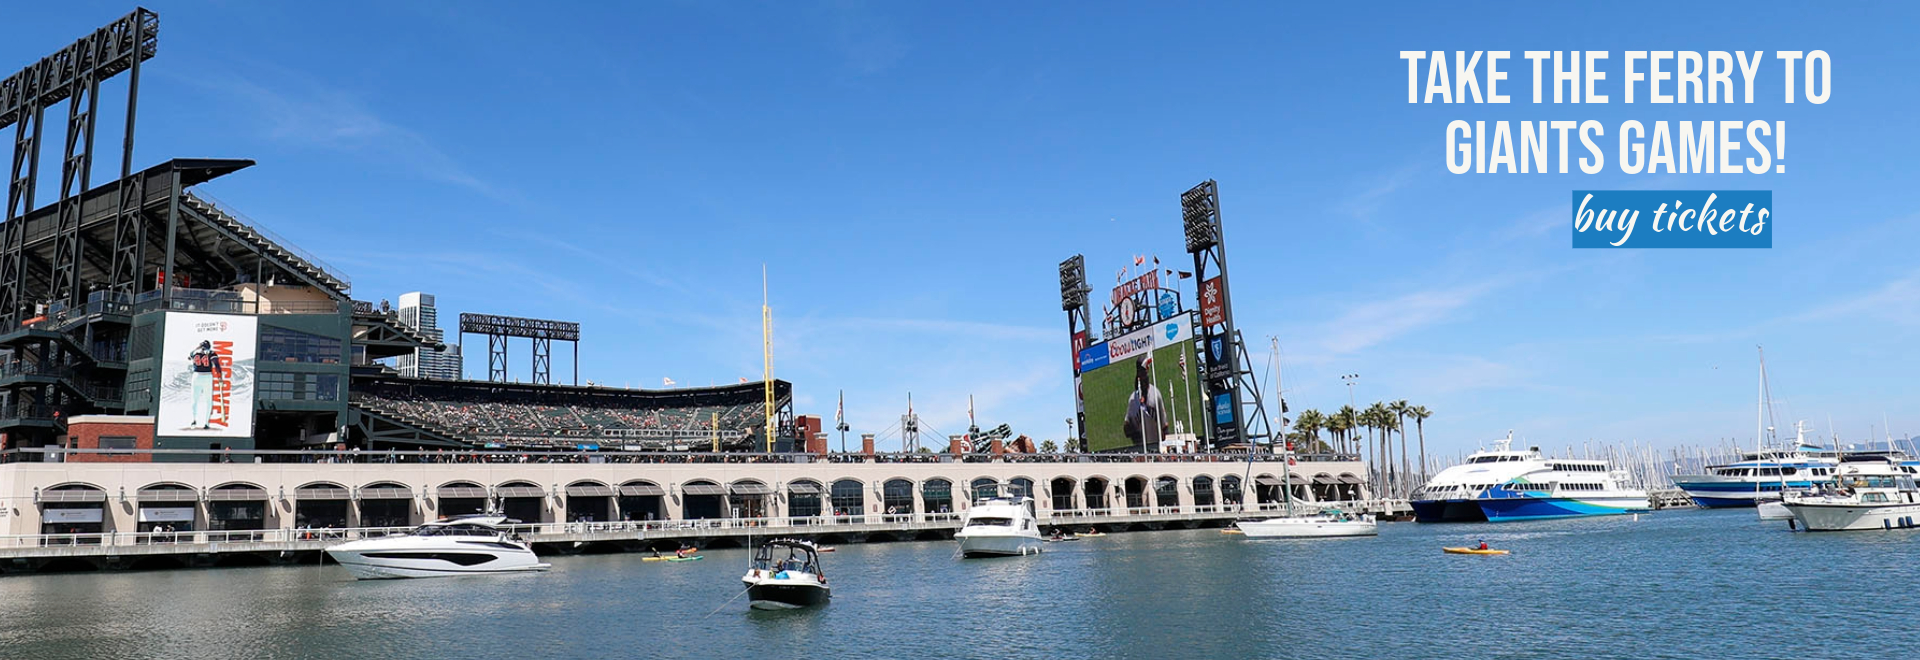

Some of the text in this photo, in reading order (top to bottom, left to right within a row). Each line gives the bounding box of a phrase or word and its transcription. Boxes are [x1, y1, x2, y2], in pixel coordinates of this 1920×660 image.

[1205, 305, 1221, 316] Dignity
[1206, 314, 1221, 324] Health
[1110, 340, 1131, 358] Coors
[1131, 335, 1151, 351] LIGHT
[193, 354, 209, 367] 44
